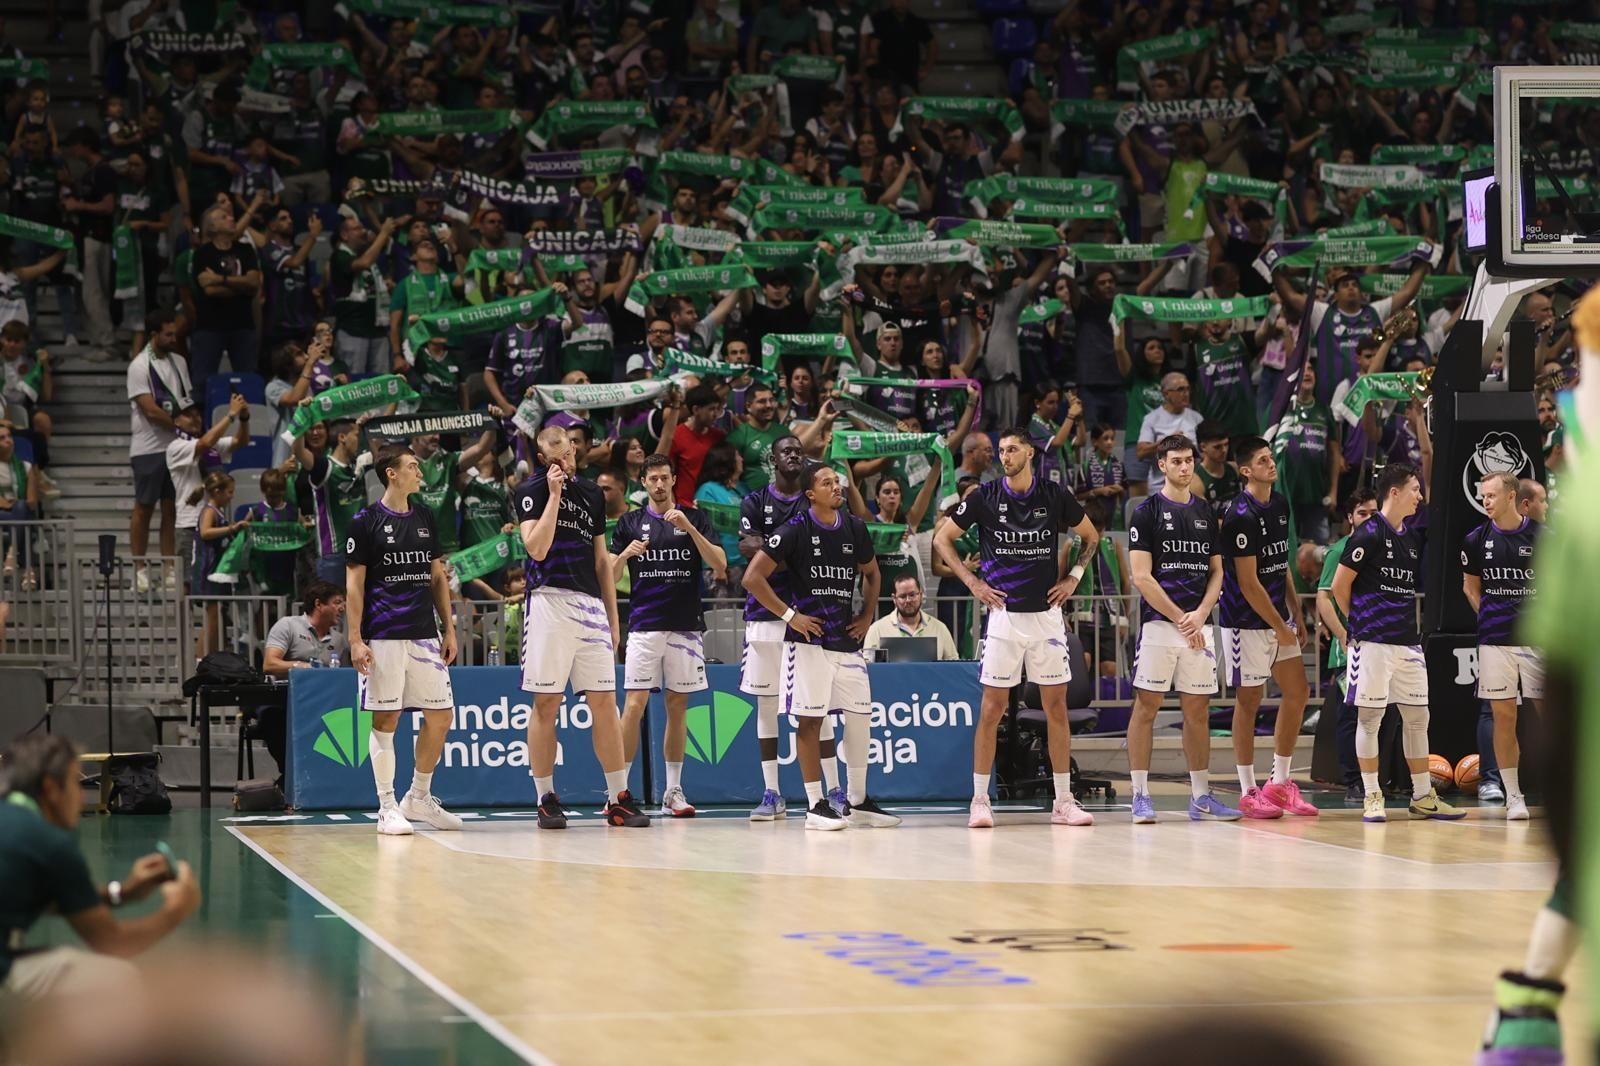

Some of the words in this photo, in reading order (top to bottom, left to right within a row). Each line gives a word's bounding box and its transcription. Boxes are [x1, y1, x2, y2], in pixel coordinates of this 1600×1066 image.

[149, 31, 246, 52] UNICAJA
[530, 230, 640, 251] UNICAJA
[1526, 232, 1560, 241] endesa
[457, 303, 512, 323] Unicaja
[1162, 299, 1213, 311] Unicaja
[333, 381, 382, 402] Unicaja
[380, 420, 422, 436] UNICAJA
[424, 413, 484, 431] BALONCESTO
[993, 529, 1051, 545] surne
[994, 546, 1051, 556] azulmarino
[1162, 538, 1211, 555] surne
[811, 565, 854, 580] surne
[1160, 560, 1208, 571] azulmarino
[1483, 567, 1535, 581] surne
[412, 696, 621, 731] Fndaió
